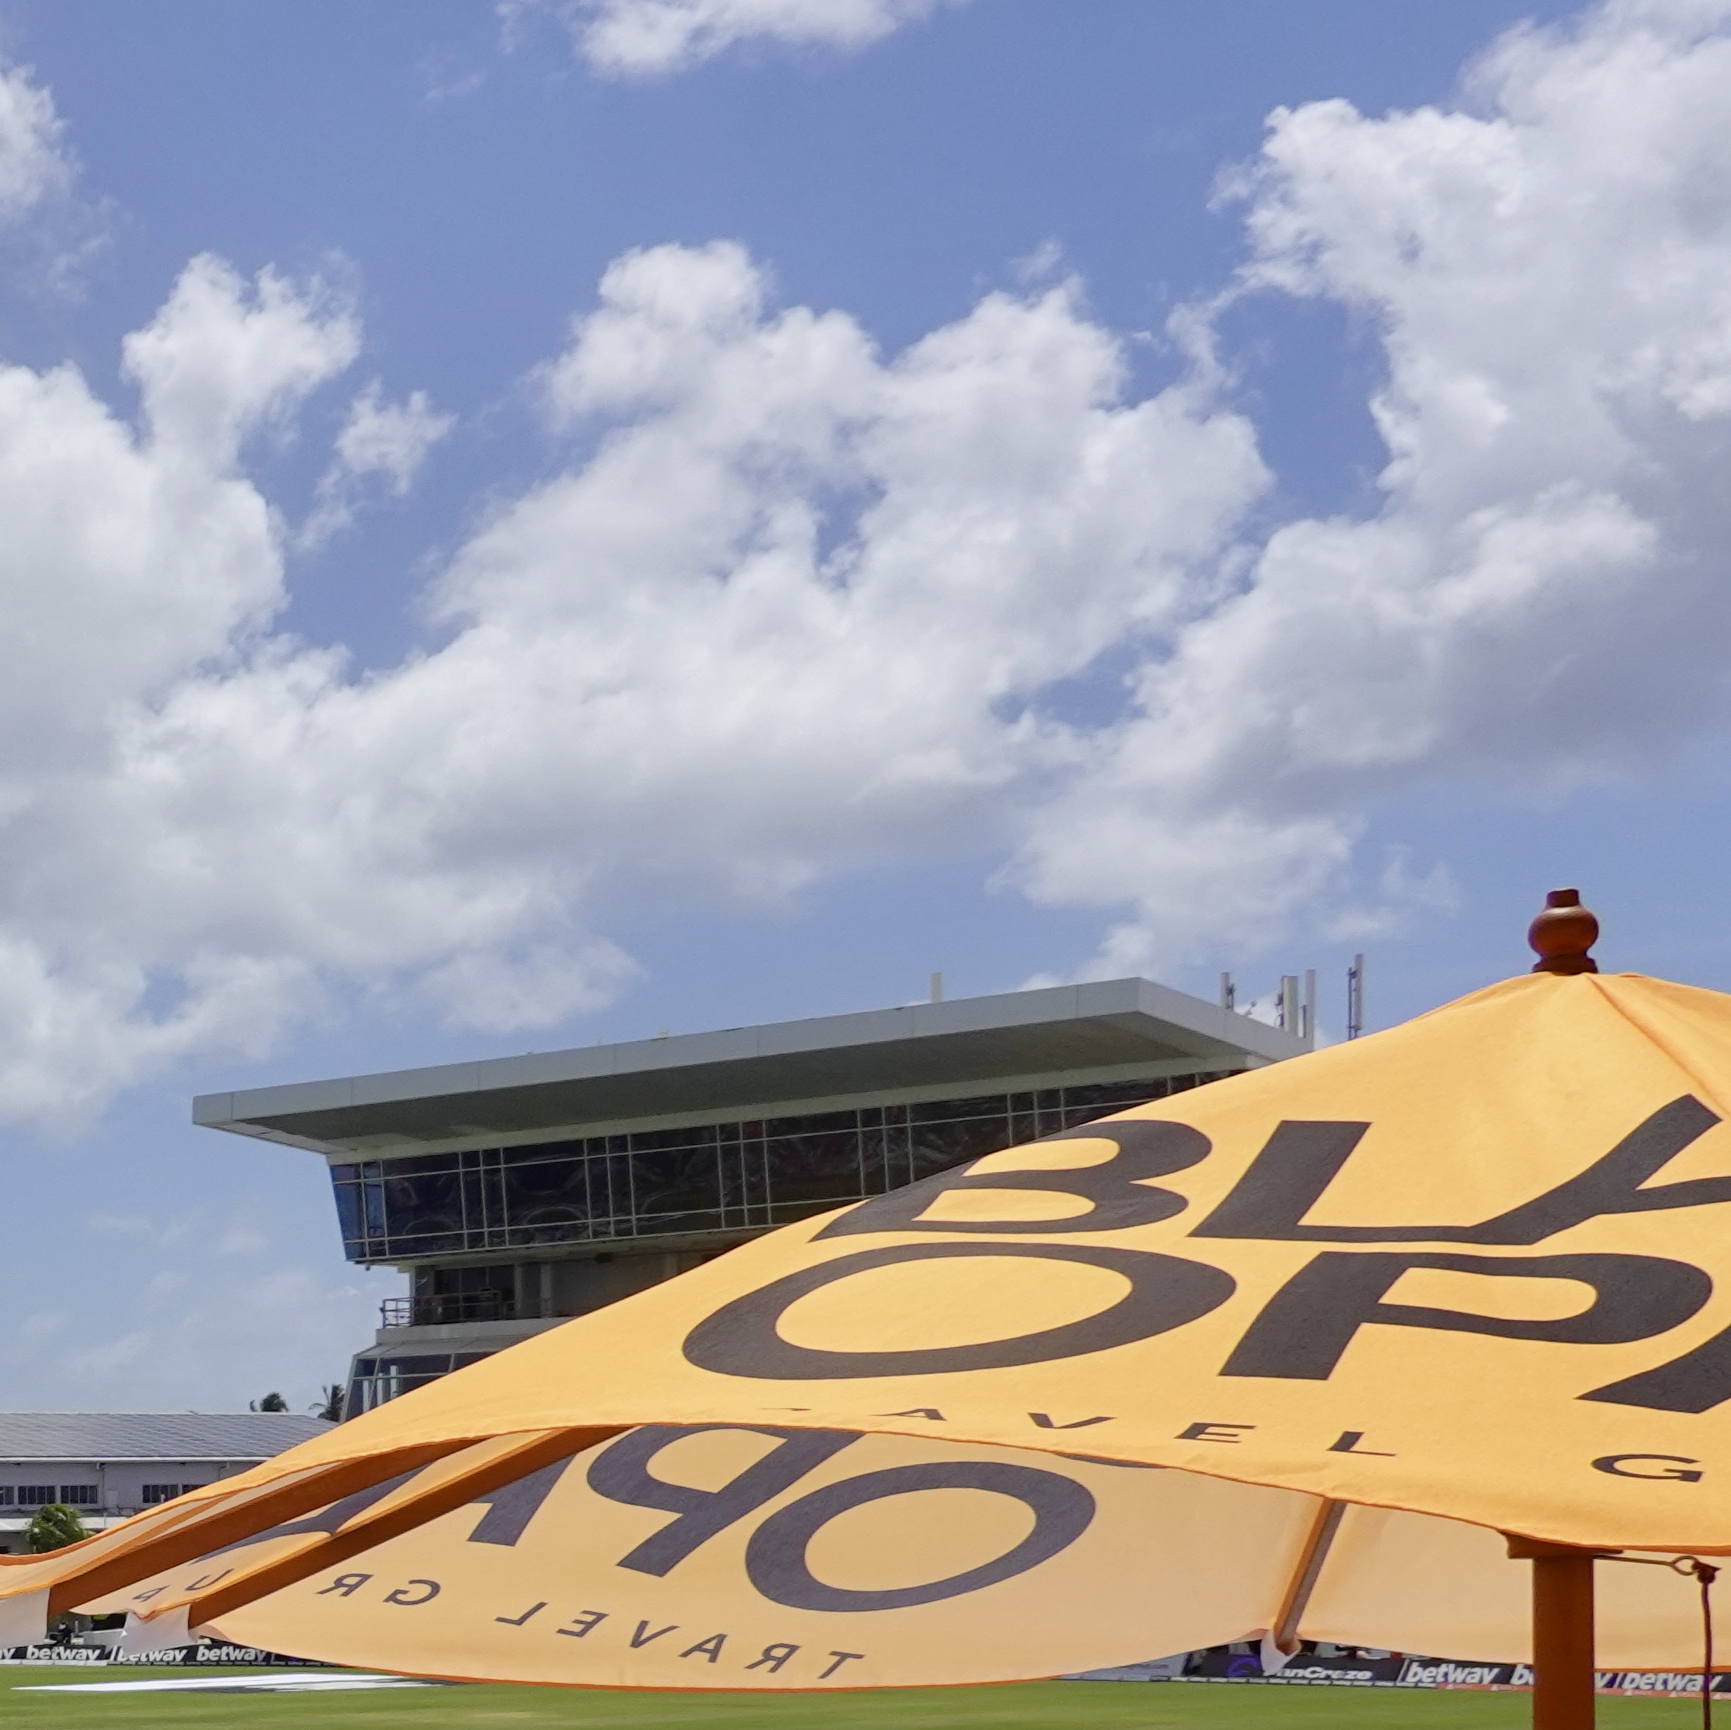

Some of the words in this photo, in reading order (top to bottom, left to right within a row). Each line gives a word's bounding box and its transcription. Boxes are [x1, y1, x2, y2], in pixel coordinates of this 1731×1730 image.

[26, 1645, 101, 1662] betway
[196, 1645, 267, 1662] betway
[1266, 1667, 1373, 1679] anCraze
[1406, 1662, 1500, 1686] betway
